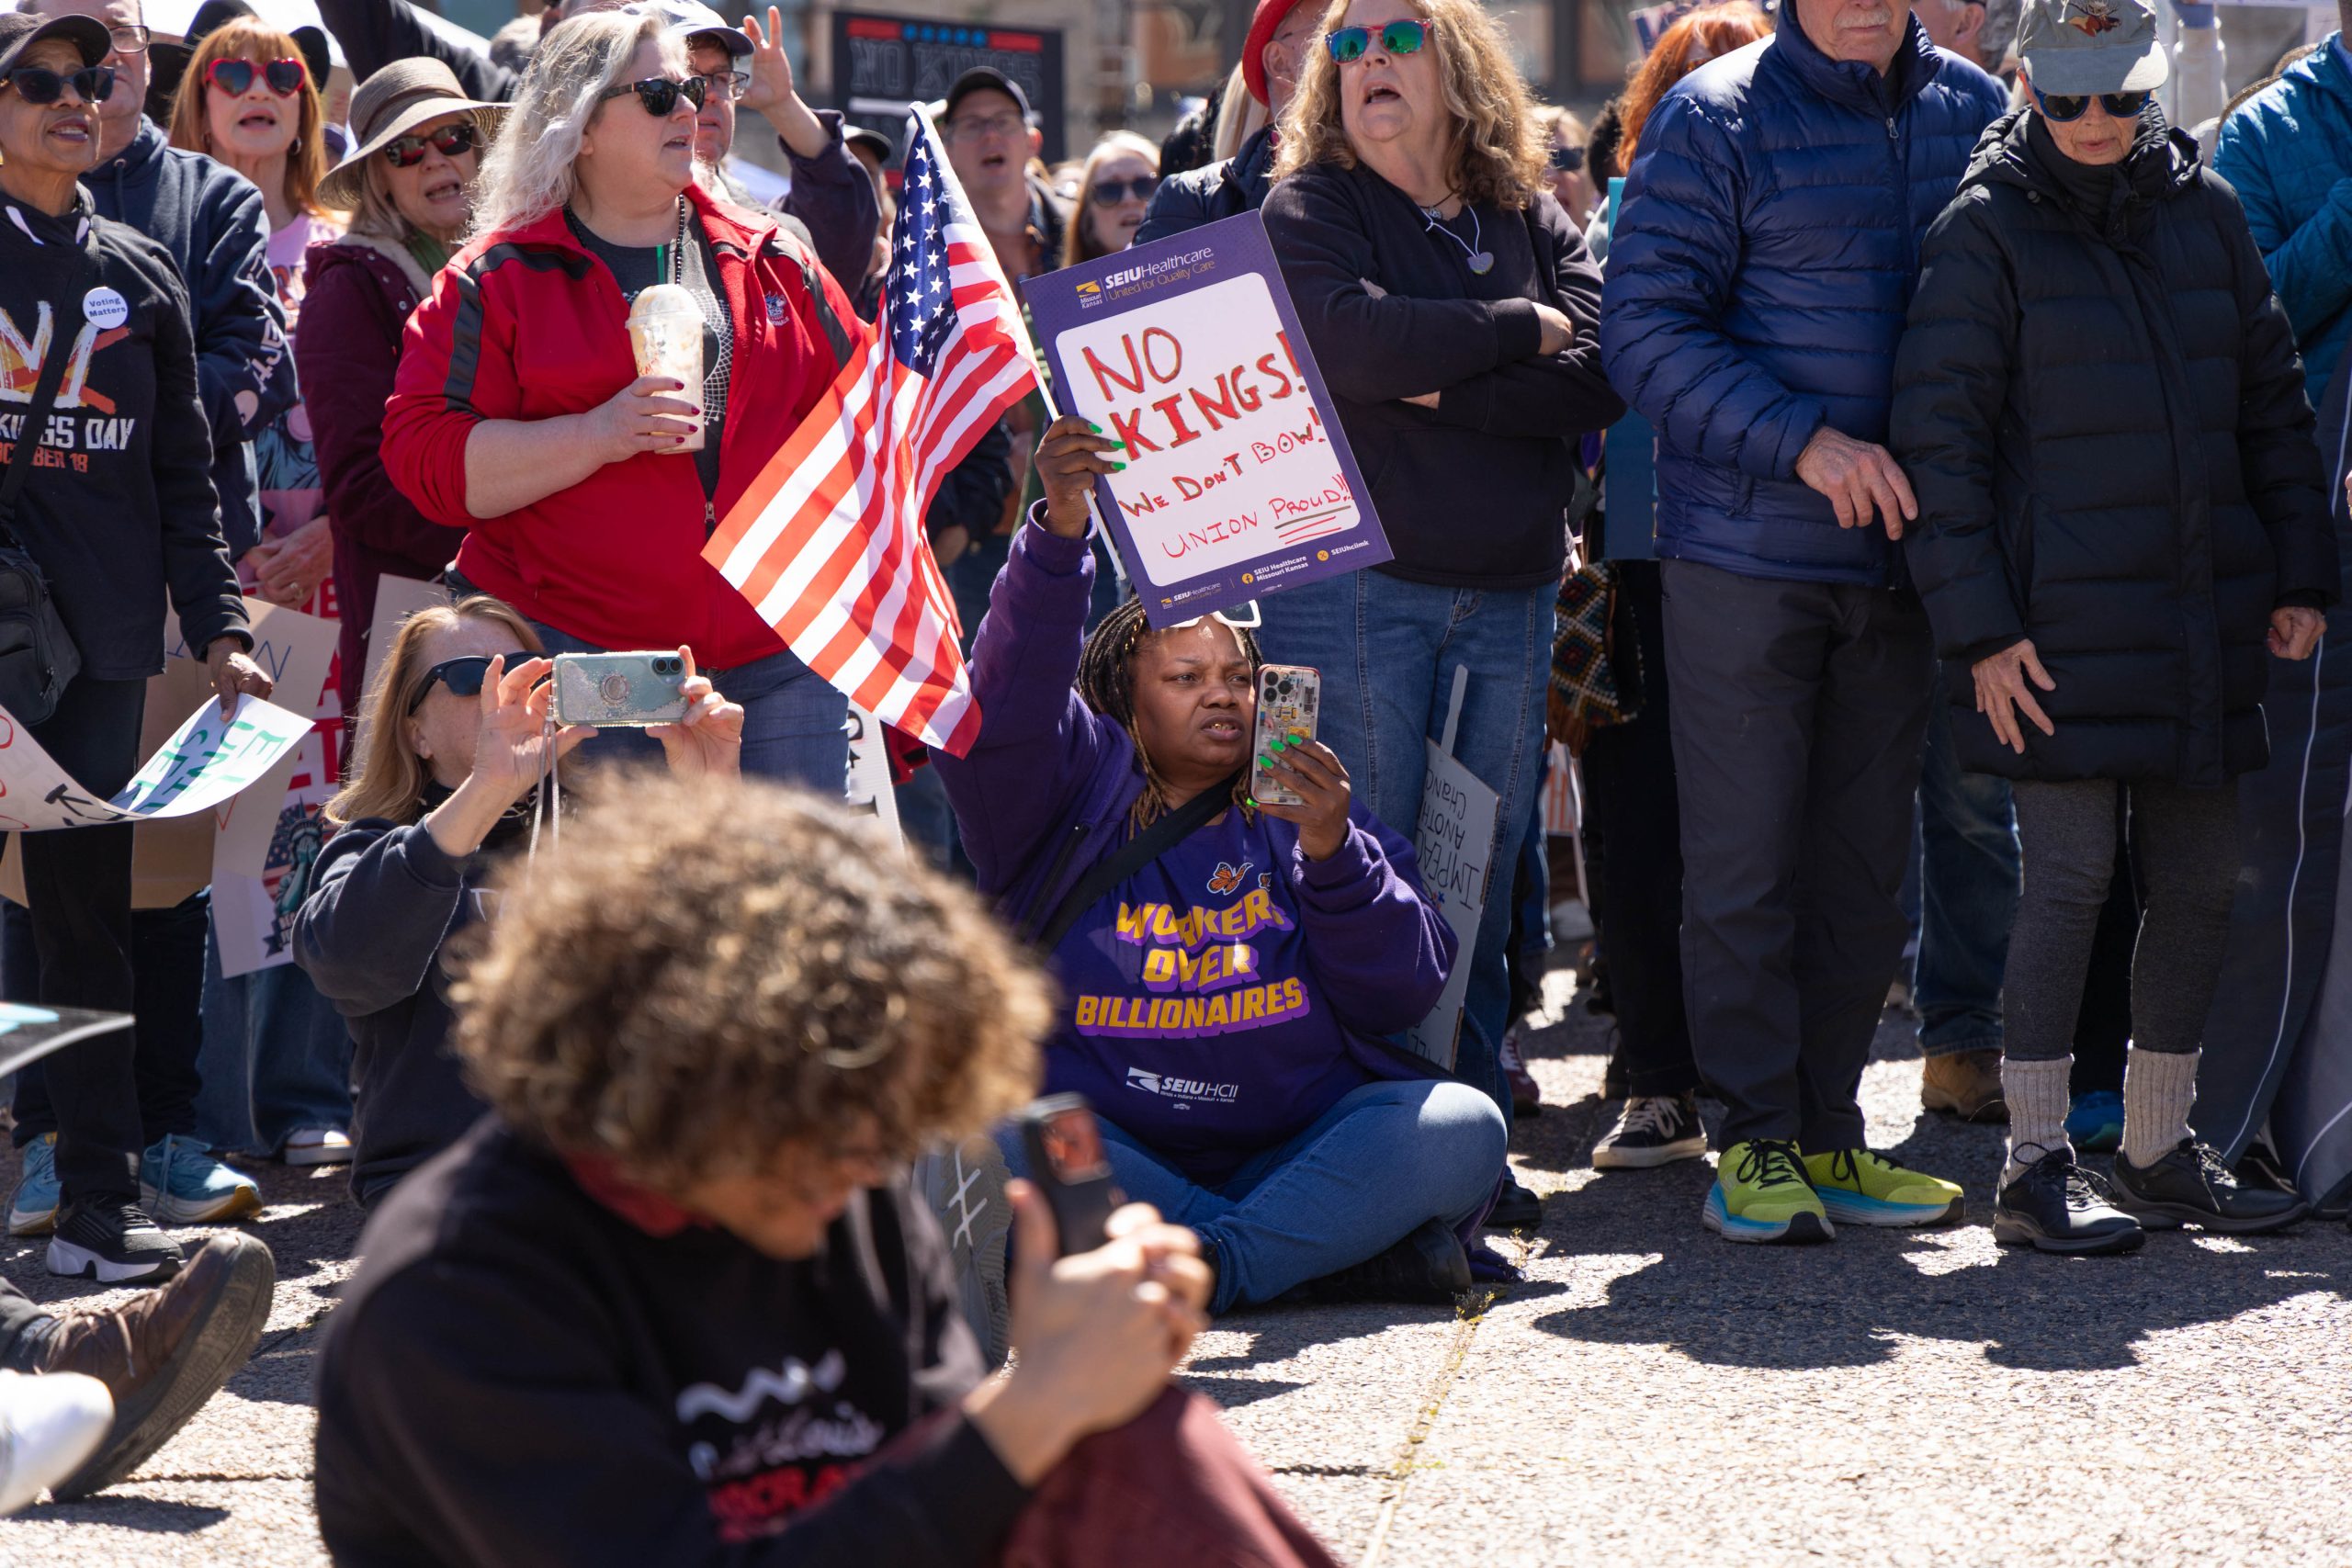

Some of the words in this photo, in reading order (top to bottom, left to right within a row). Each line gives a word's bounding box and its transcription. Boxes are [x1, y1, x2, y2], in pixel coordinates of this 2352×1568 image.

[1108, 283, 1141, 300] United
[1142, 278, 1156, 290] for
[1157, 267, 1192, 286] Quality
[1193, 260, 1216, 274] Care
[88, 296, 121, 308] Voting
[89, 306, 127, 318] Matters
[1081, 326, 1183, 402] NO
[1108, 330, 1307, 461] KINGS!
[85, 418, 135, 450] DAY
[69, 452, 89, 473] 18
[1161, 511, 1258, 558] UNION
[1253, 563, 1269, 576] SEIU
[1270, 555, 1307, 571] Healthcare
[1256, 567, 1285, 581] Missouri
[1285, 561, 1309, 574] Kansas
[1421, 801, 1466, 850] ANOTH
[1416, 829, 1480, 911] IMPEAC
[1143, 944, 1259, 993] OVER
[1076, 976, 1309, 1036] BILLIONAIRES
